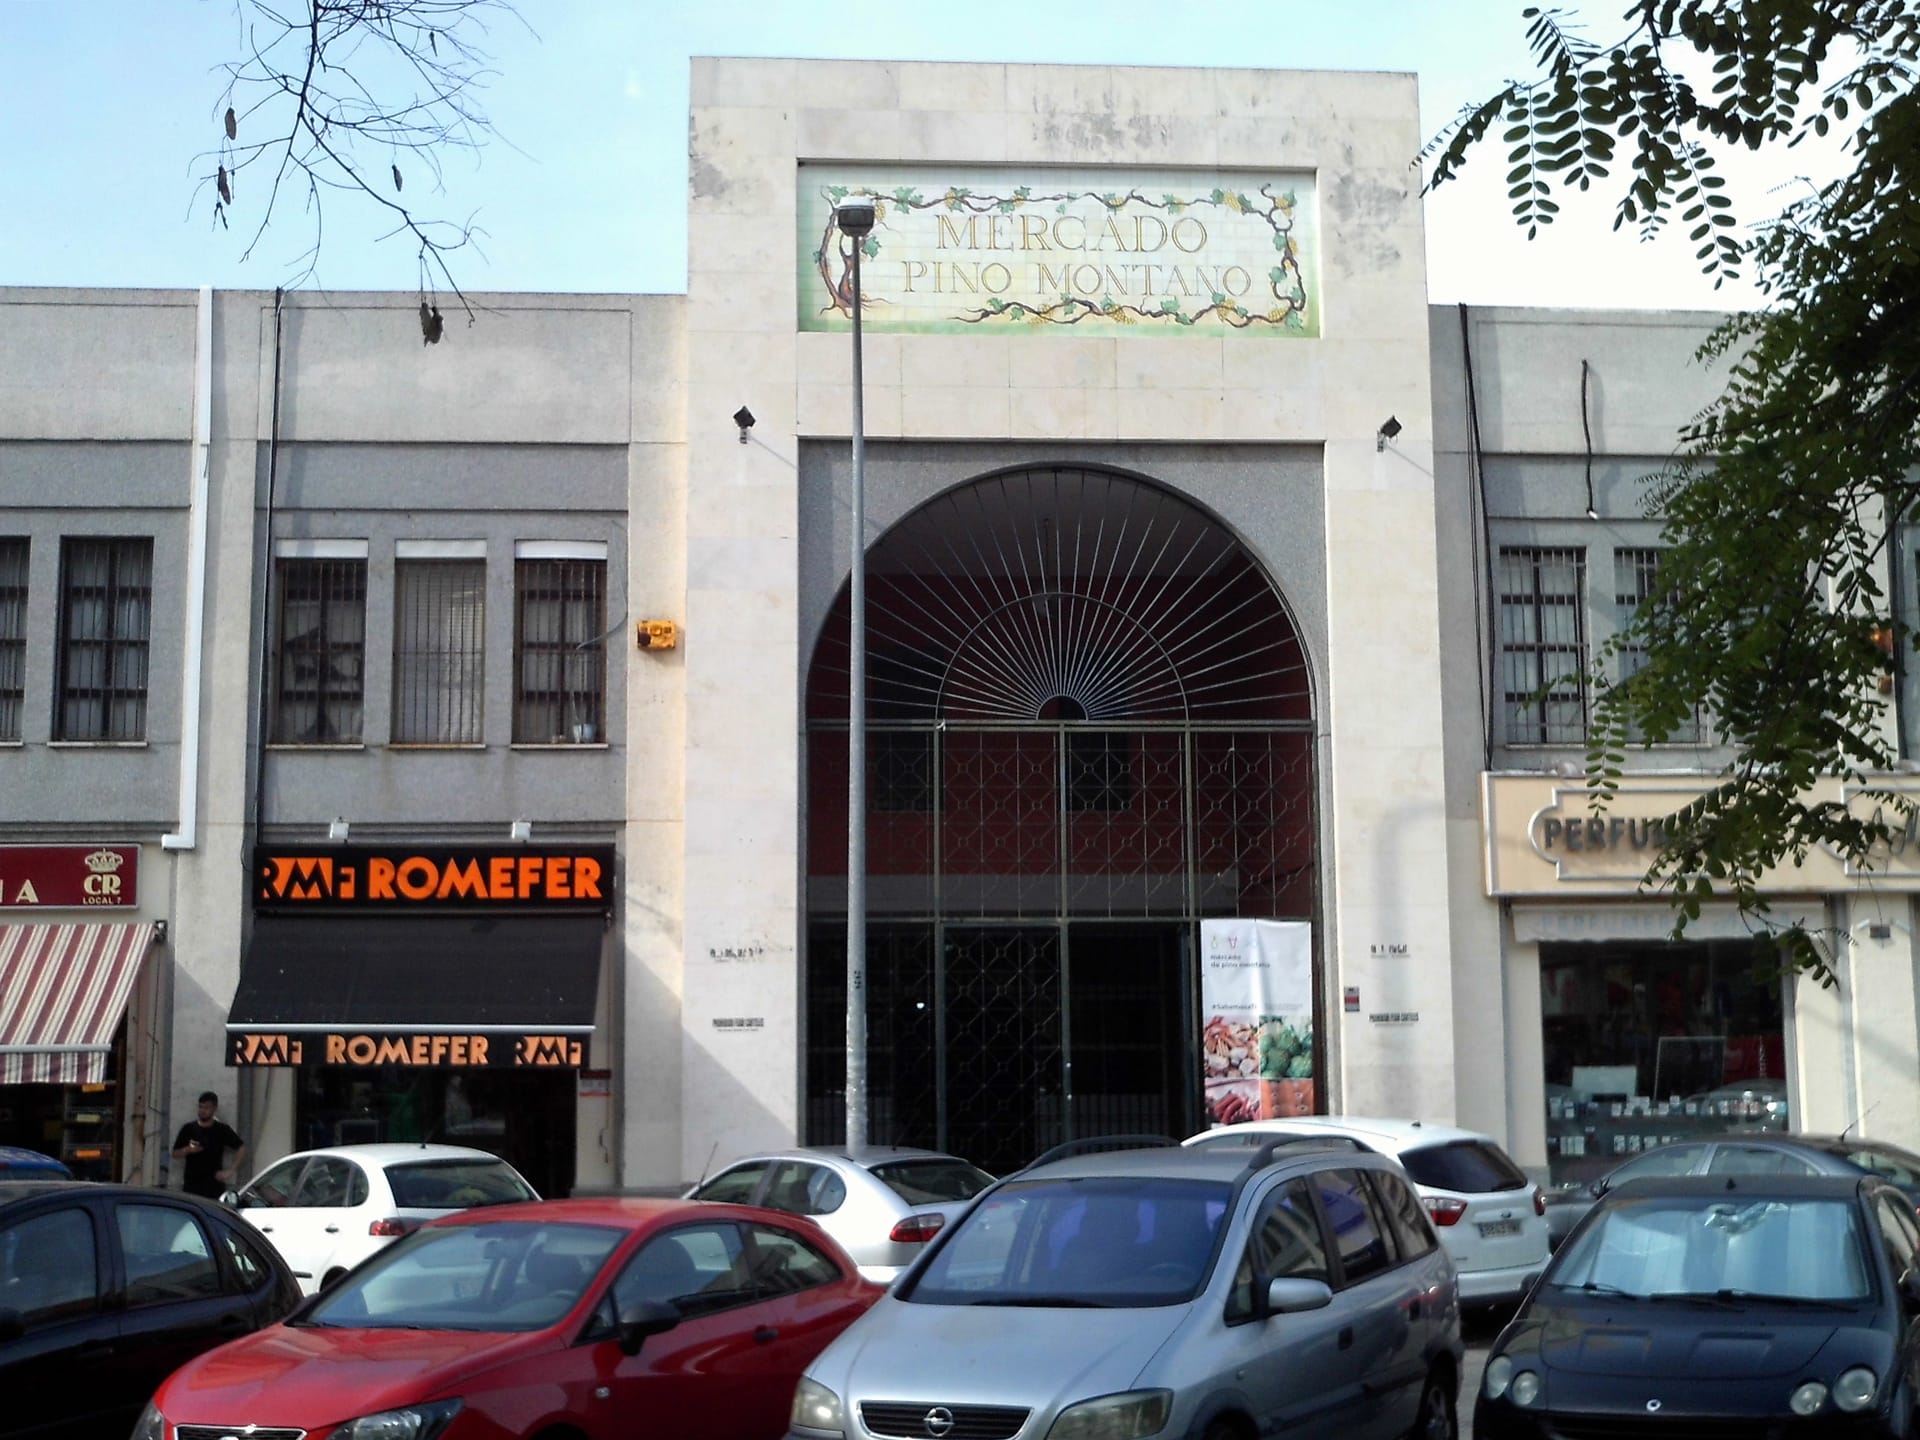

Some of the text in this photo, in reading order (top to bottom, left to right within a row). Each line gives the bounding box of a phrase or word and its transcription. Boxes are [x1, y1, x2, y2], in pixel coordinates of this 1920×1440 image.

[934, 213, 1209, 254] MERCADO
[900, 259, 1252, 297] PINO MONTANO
[83, 873, 122, 896] CR
[368, 856, 603, 900] ROMEFER
[82, 896, 113, 905] LOCAL
[326, 1035, 490, 1065] ROMEFER
